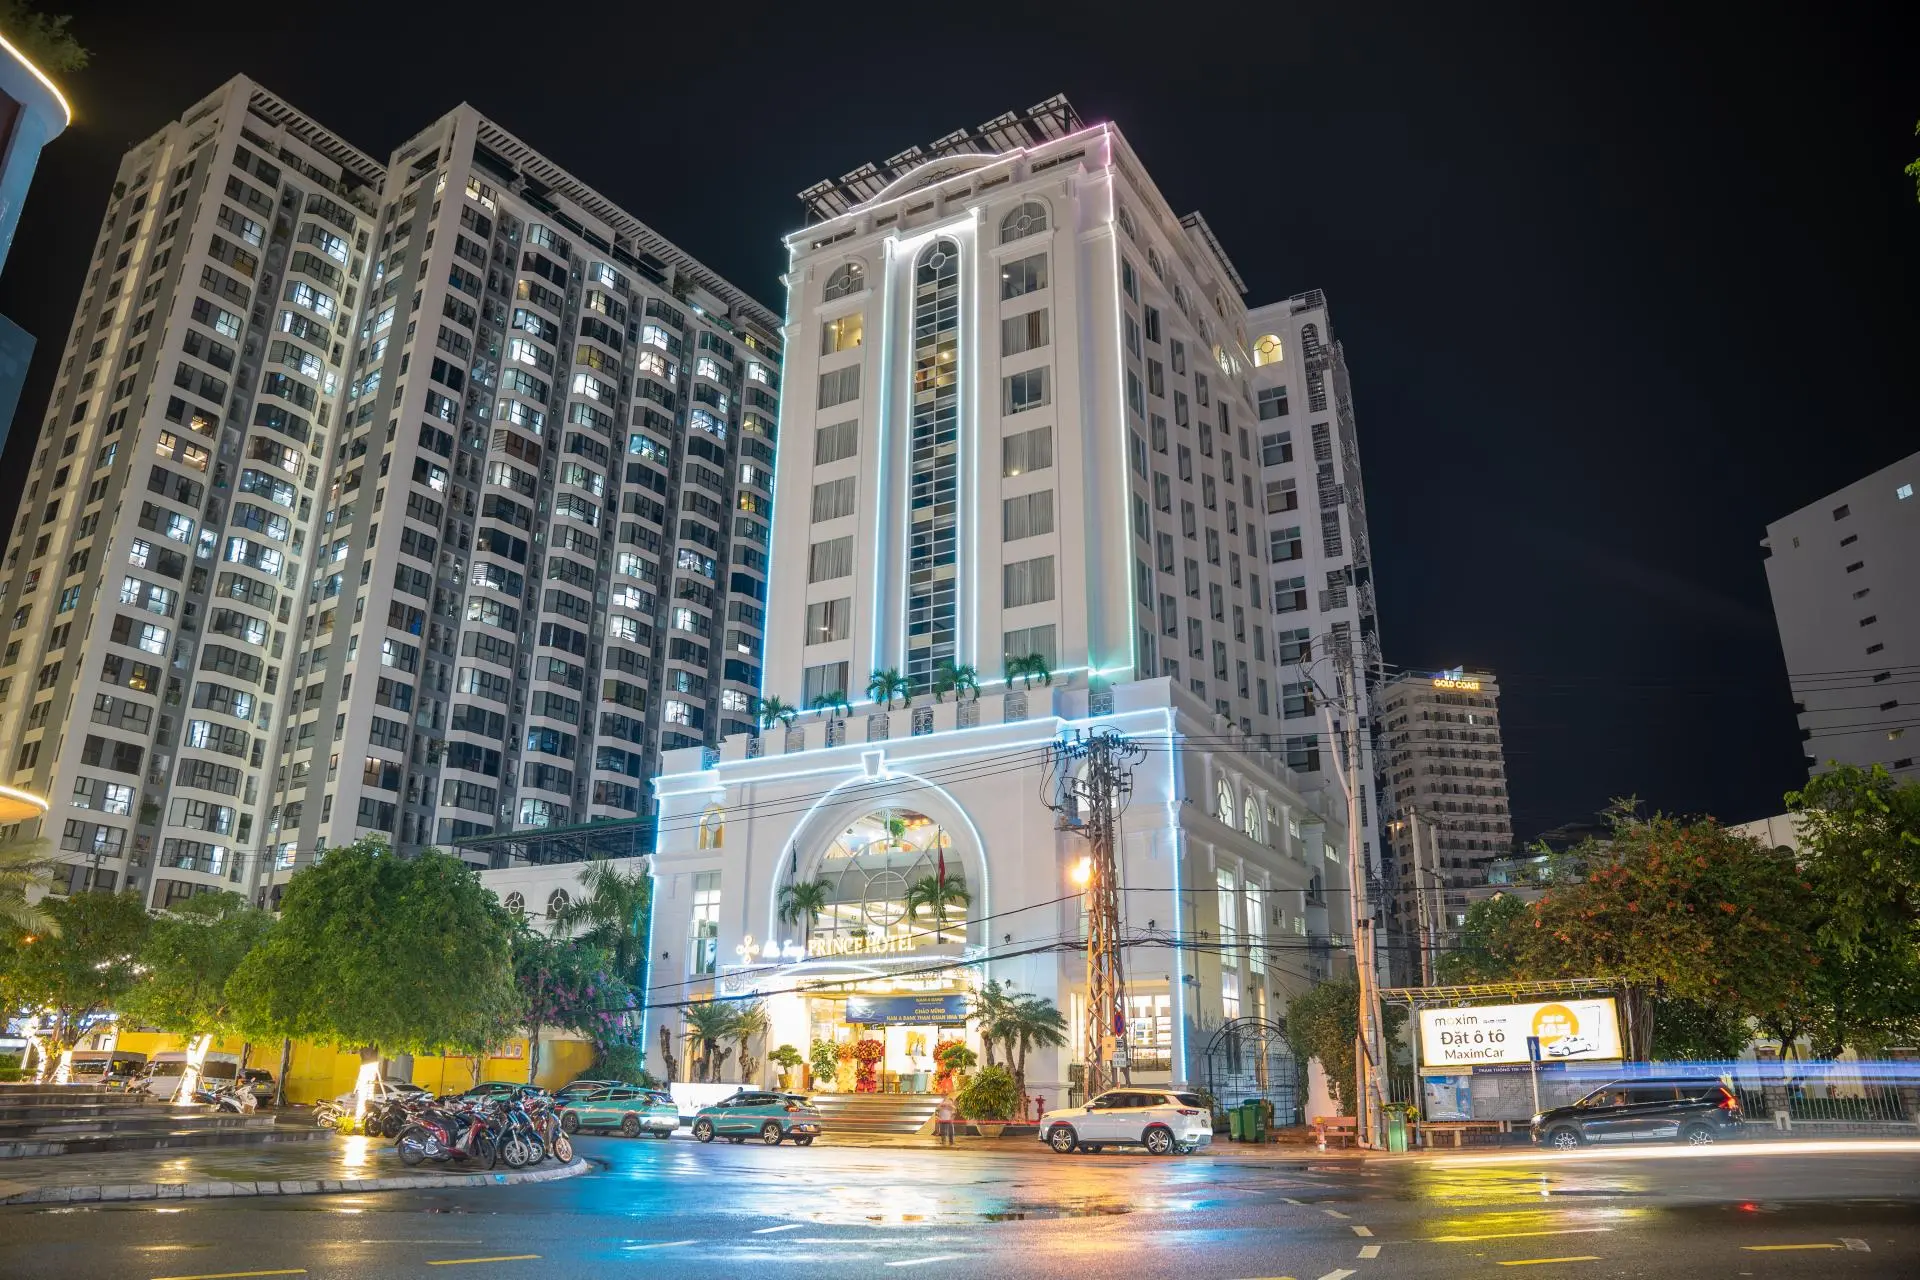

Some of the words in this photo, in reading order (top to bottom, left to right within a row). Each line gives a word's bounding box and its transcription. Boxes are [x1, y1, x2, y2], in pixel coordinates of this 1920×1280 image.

[1434, 679, 1455, 688] GOLD
[1455, 681, 1479, 690] COAST
[807, 938, 864, 956] PRINCE
[865, 934, 916, 953] HOTEL
[1435, 1014, 1478, 1026] maxim
[1440, 1031, 1469, 1047] Đặt
[1474, 1030, 1484, 1044] ô
[1488, 1029, 1505, 1043] tô
[1445, 1048, 1504, 1059] MaximCar
